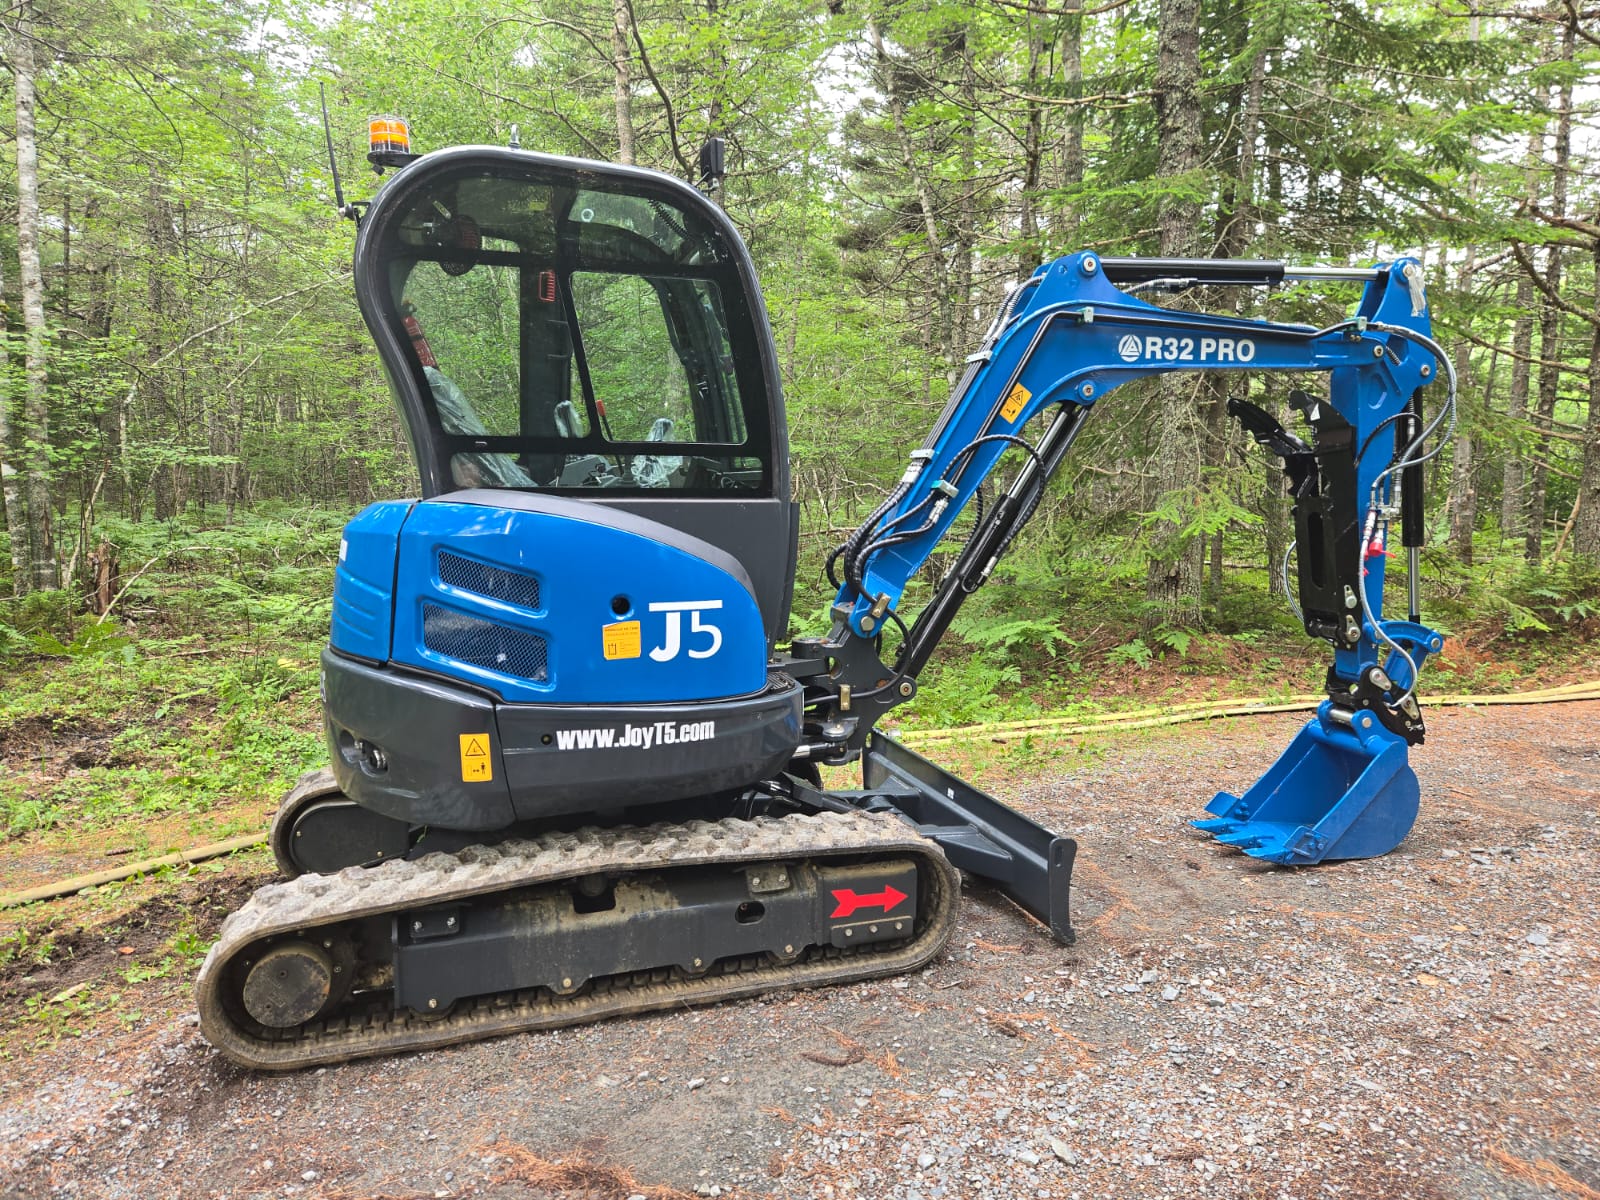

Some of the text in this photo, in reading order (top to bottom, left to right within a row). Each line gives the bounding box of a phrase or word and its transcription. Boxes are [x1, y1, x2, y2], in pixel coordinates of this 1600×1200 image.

[1145, 336, 1255, 362] R32 PRO
[556, 721, 715, 750] www.JoyT5.com
